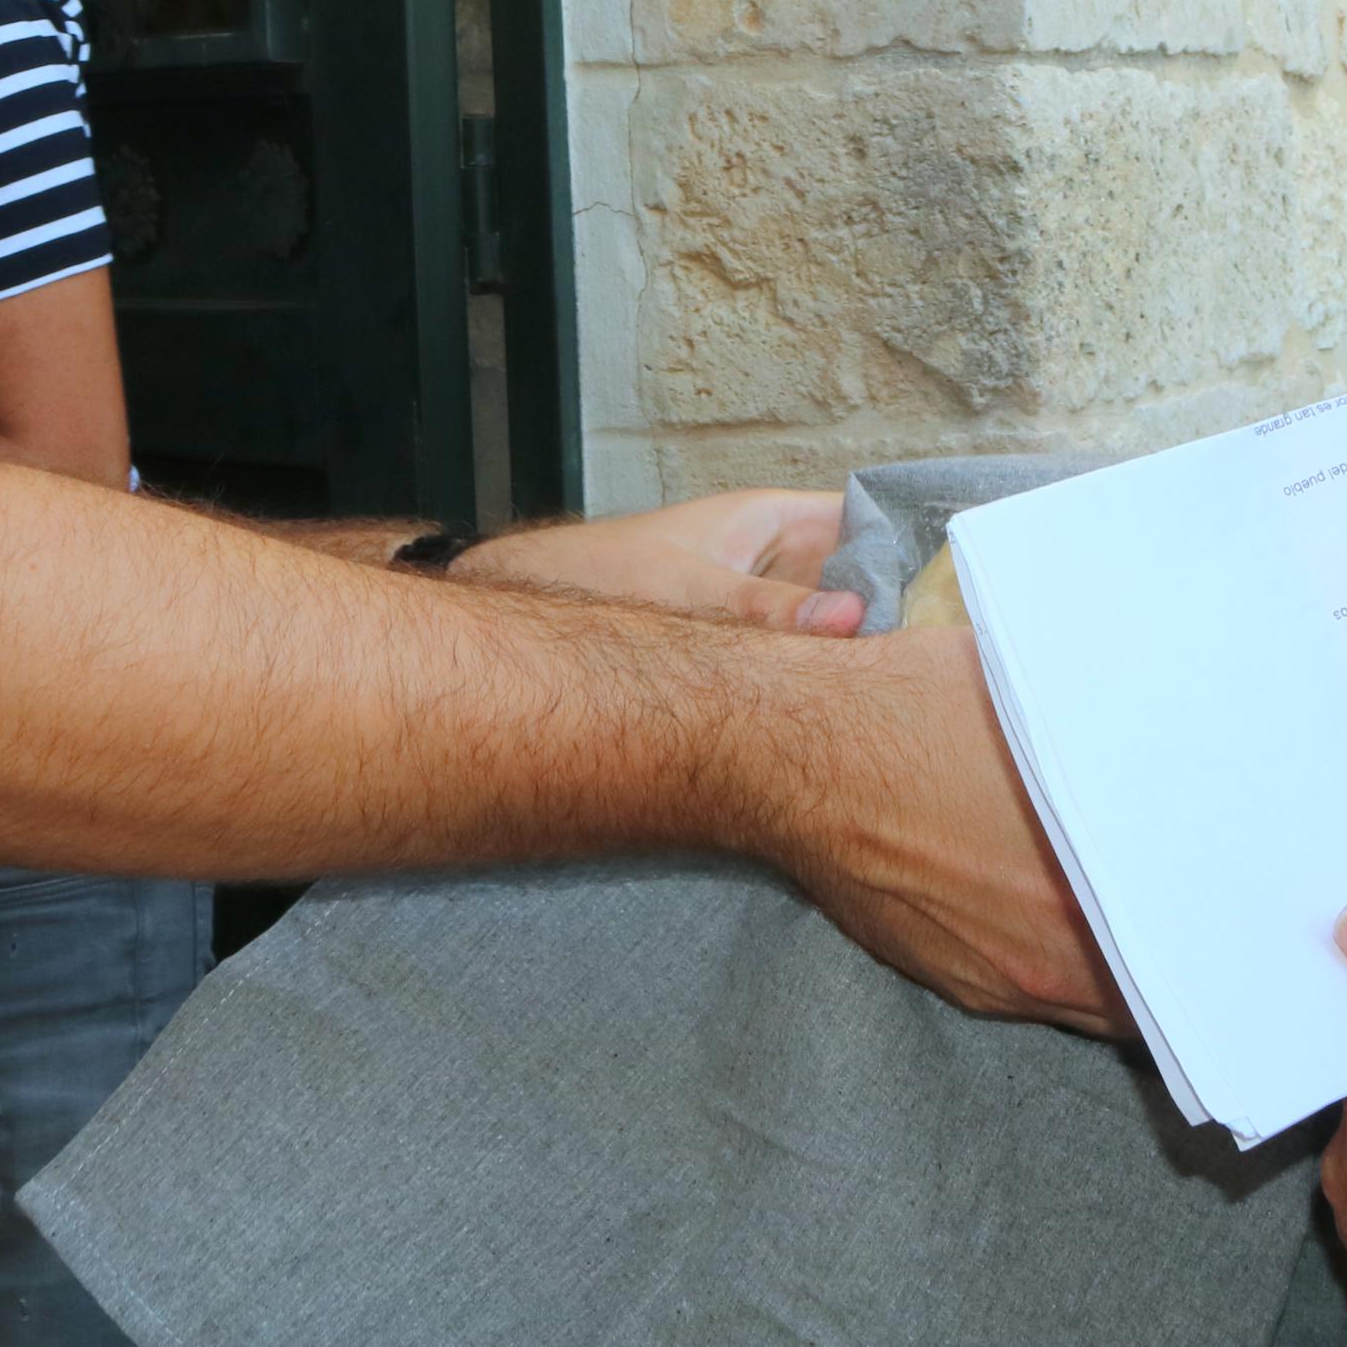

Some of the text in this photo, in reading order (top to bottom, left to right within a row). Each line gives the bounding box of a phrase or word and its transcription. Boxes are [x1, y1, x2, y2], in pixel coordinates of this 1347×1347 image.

[1293, 406, 1316, 424] tan
[1316, 400, 1333, 414] es
[1251, 411, 1294, 439] grande
[1327, 462, 1347, 480] del
[1283, 469, 1325, 496] pueblo
